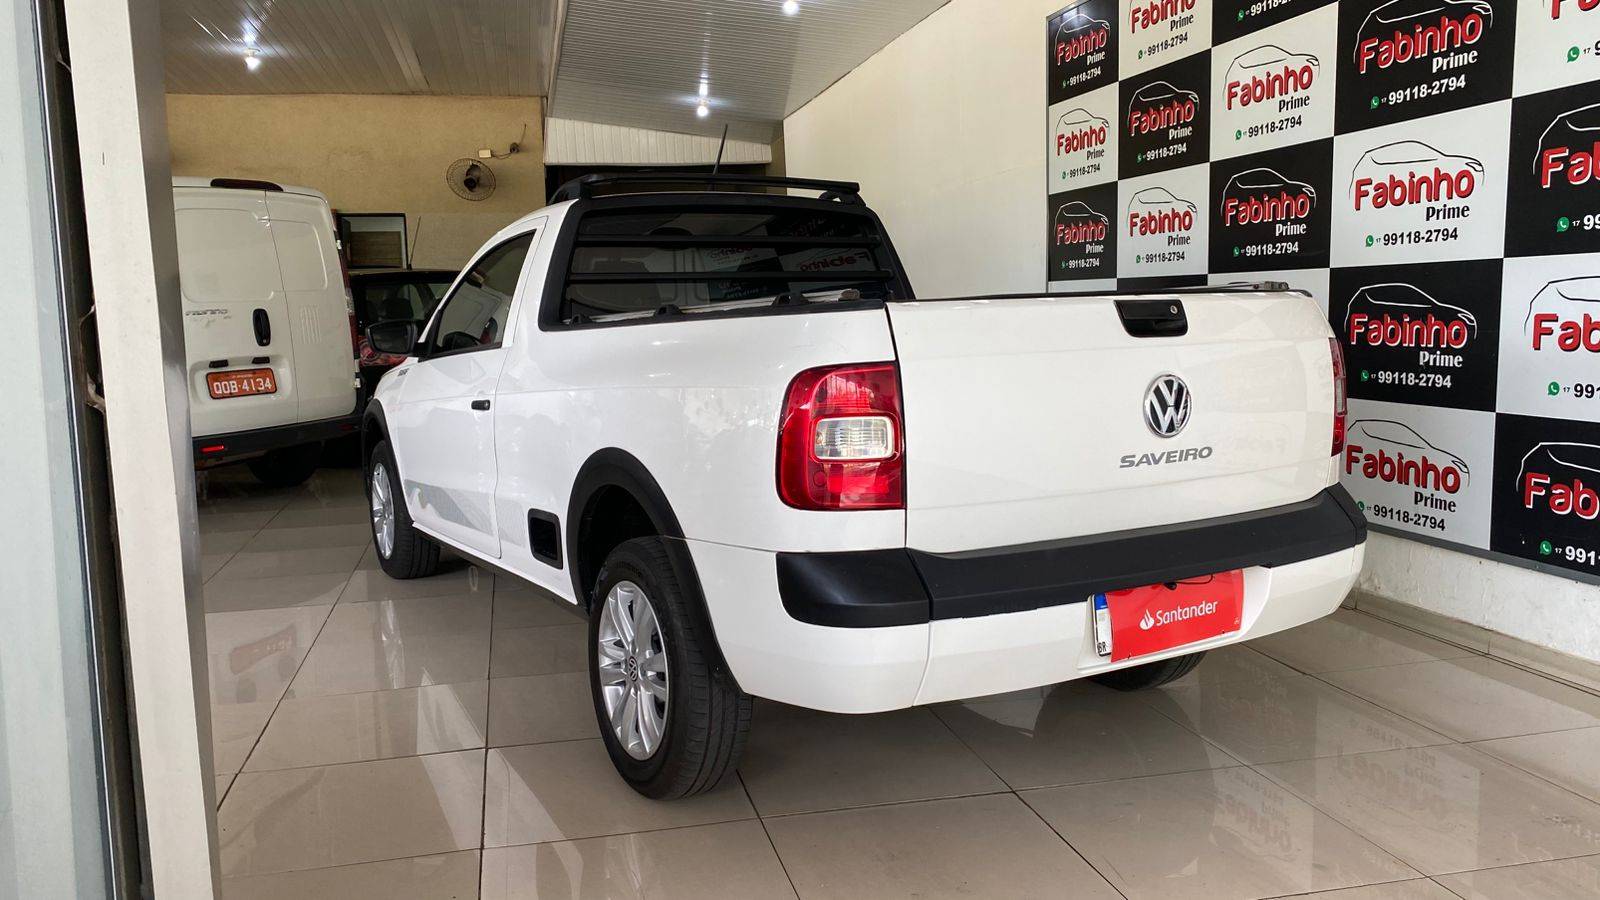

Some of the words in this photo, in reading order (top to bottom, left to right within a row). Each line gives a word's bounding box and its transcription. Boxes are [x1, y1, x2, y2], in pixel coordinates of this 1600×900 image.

[1056, 28, 1107, 66] Fabinho
[1147, 32, 1188, 56] 99118-2794
[1359, 13, 1483, 75] Fabinho
[1432, 50, 1478, 73] Prime
[1226, 64, 1314, 110] Fabinho
[1388, 74, 1466, 105] 99118-2794
[1278, 95, 1310, 113] Prime
[1129, 100, 1195, 137] Fabinho
[1248, 114, 1302, 138] 99118-2794
[1056, 125, 1107, 156] Fabinho
[1146, 143, 1187, 161] 99118-2794
[1354, 167, 1475, 211] Fabinho
[1224, 191, 1310, 227] Fabinho
[1426, 204, 1470, 222] Prime
[1056, 219, 1106, 246] Fabinho
[1129, 207, 1194, 237] Fabinho
[1275, 221, 1307, 237] Prime
[1167, 233, 1190, 246] Prime
[1246, 241, 1299, 256] 99118-2794
[1383, 227, 1458, 246] 99118-2794
[1145, 251, 1185, 264] 99118-2794
[1351, 313, 1468, 349] Fabinho
[1419, 351, 1463, 368] Prime
[1378, 370, 1452, 388] 99118-2794
[1119, 446, 1213, 468] SAVEIRO
[1345, 445, 1461, 494] Fabinho
[1414, 491, 1456, 513] Prime
[1373, 504, 1446, 531] 99118-2794
[1565, 545, 1600, 566] 991
[1156, 601, 1218, 626] Santander
